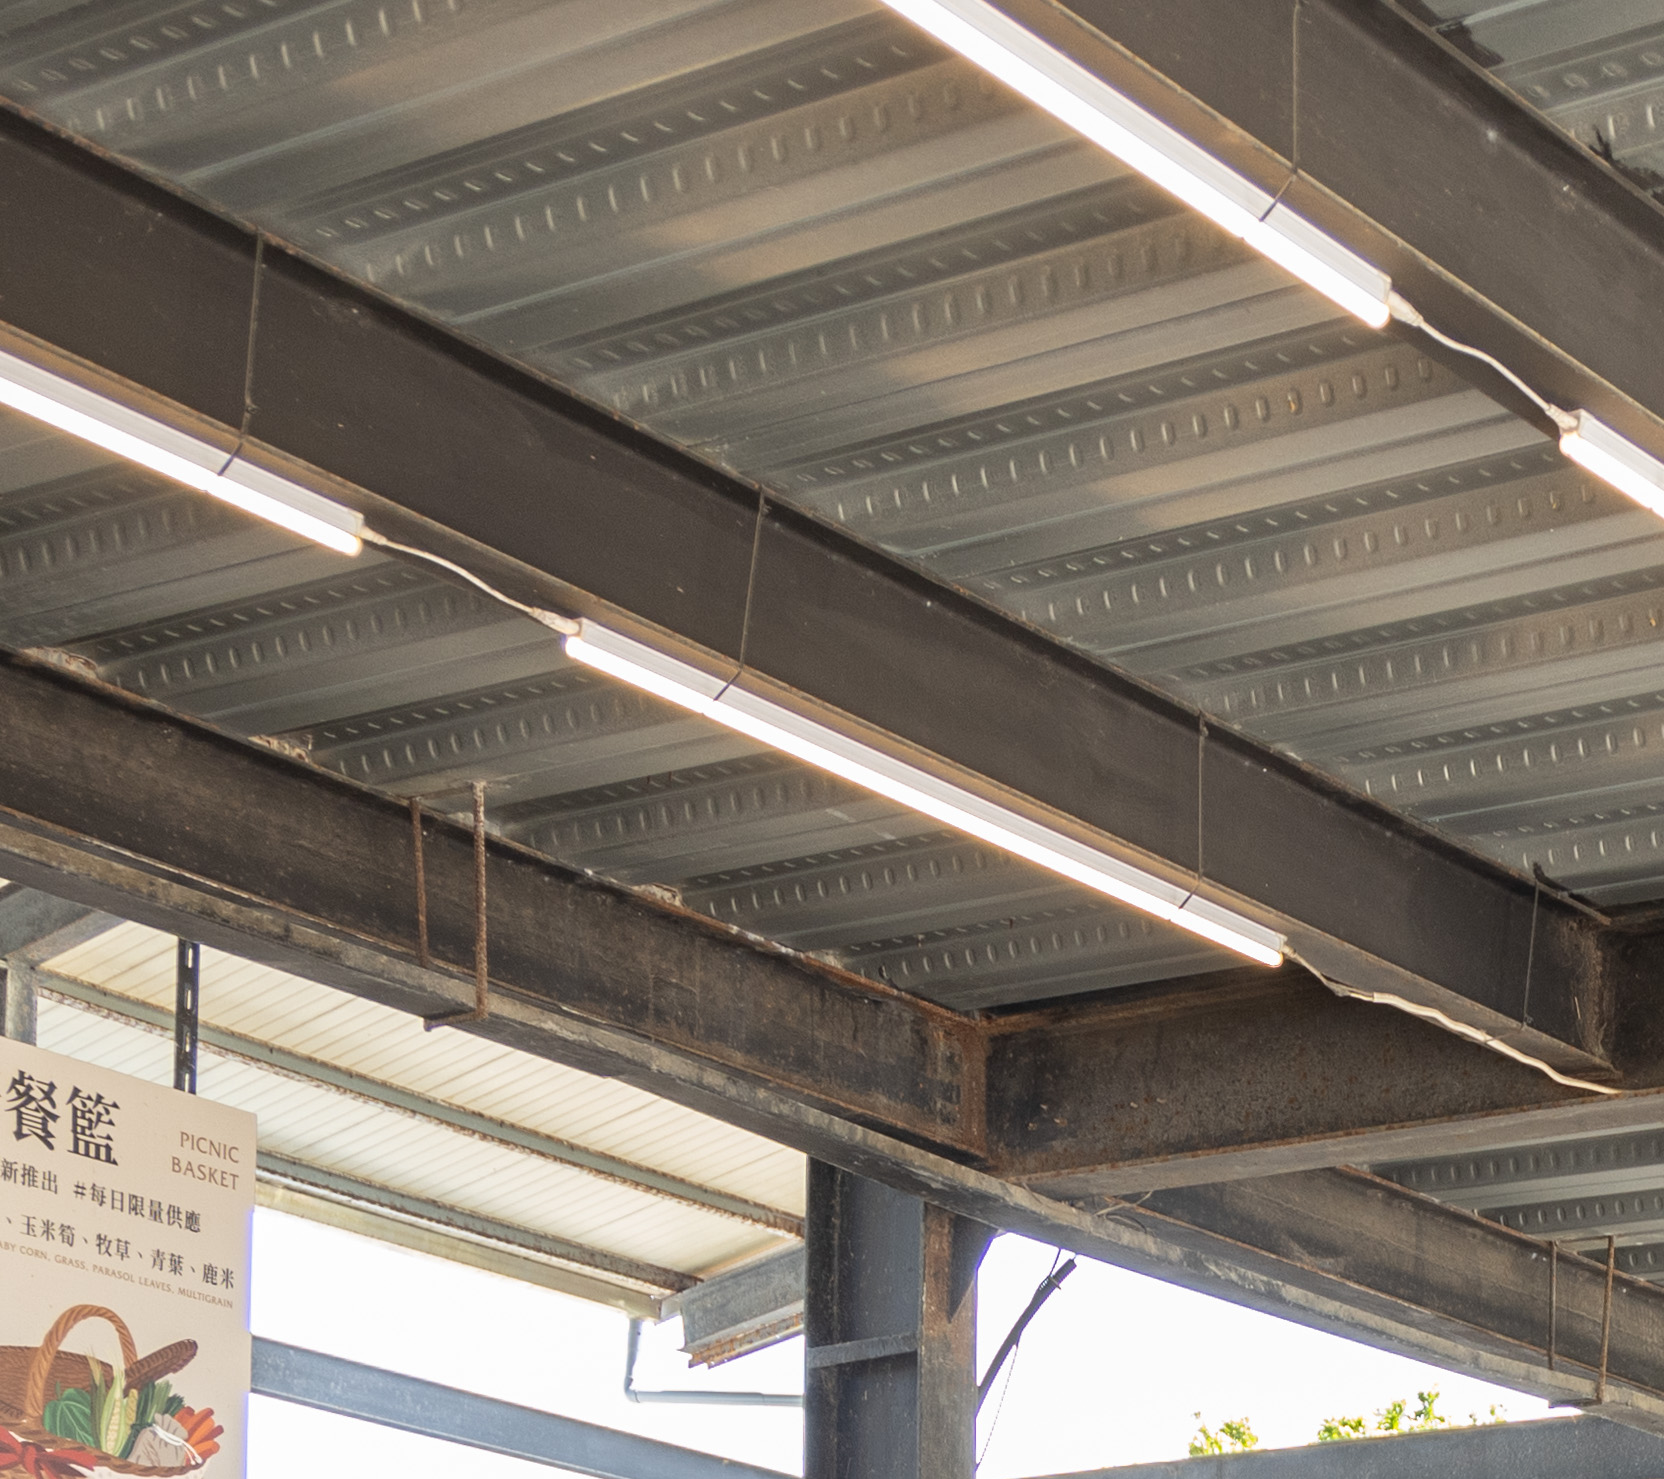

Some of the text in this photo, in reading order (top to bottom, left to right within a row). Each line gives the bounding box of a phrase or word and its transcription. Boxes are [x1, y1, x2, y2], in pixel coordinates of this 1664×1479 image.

[179, 1130, 241, 1165] PICNIC
[170, 1155, 241, 1191] BASKET
[72, 1180, 203, 1234] #每日限量供應
[91, 1263, 136, 1284] PARASOL
[177, 1286, 234, 1310] MULTIGRAIN
